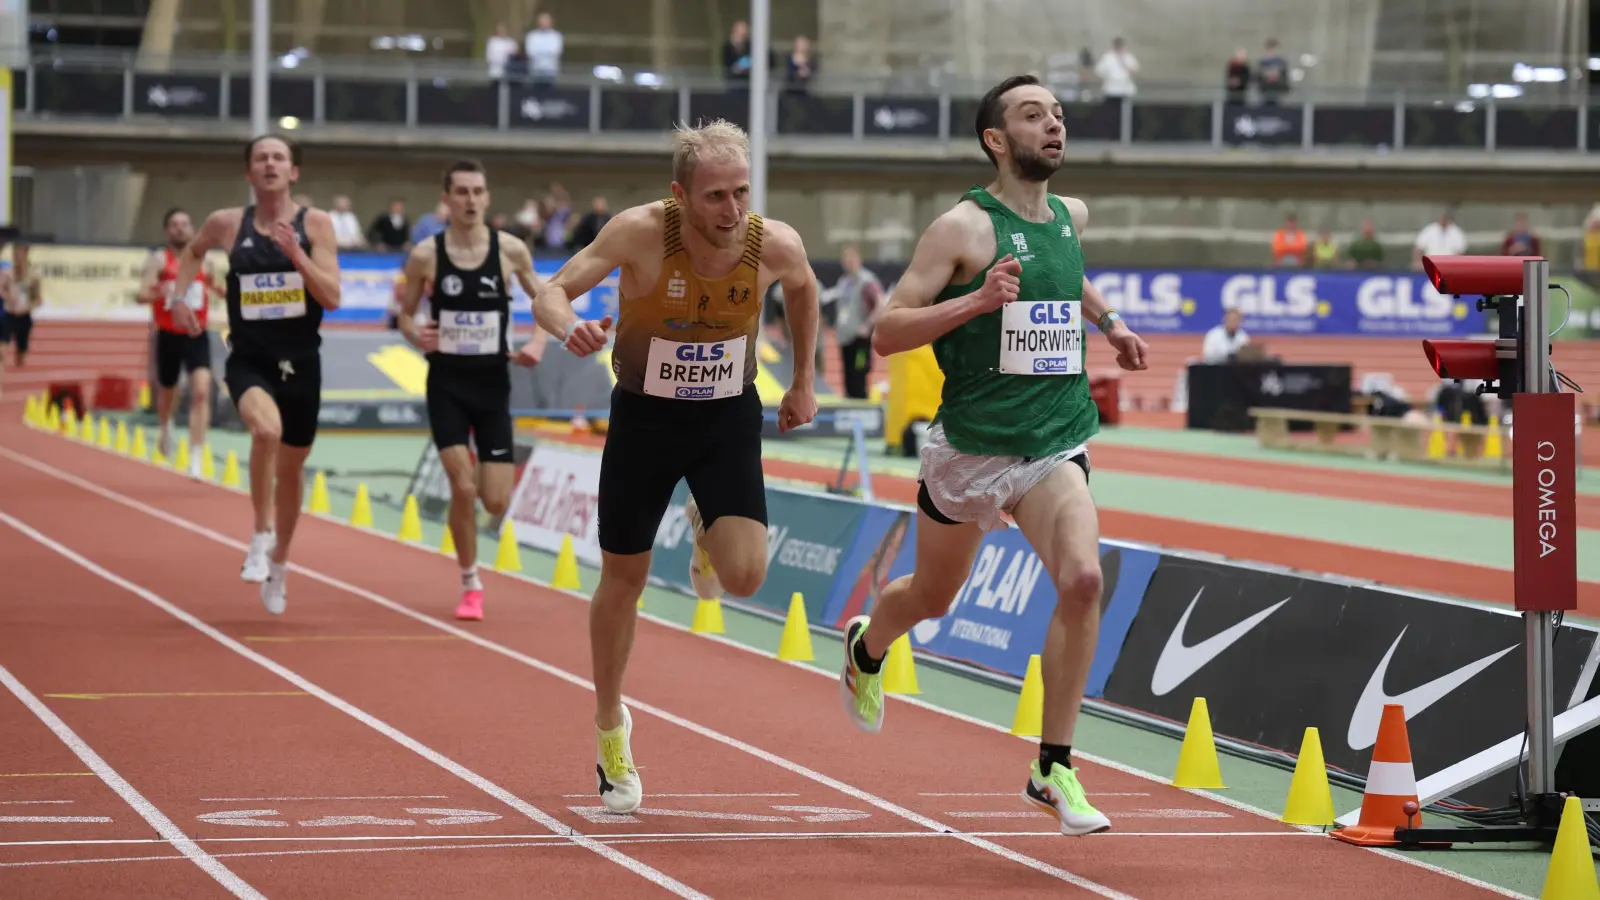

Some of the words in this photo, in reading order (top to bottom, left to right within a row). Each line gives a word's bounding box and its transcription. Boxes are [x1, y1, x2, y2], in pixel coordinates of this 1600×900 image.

[243, 290, 304, 305] PARSONS
[1005, 329, 1081, 352] THORWIRTH
[659, 361, 734, 382] BREMM
[1049, 359, 1068, 368] PLAN
[691, 388, 714, 396] PLAN
[1537, 468, 1557, 559] OMEGA
[962, 544, 1044, 616] PLAN
